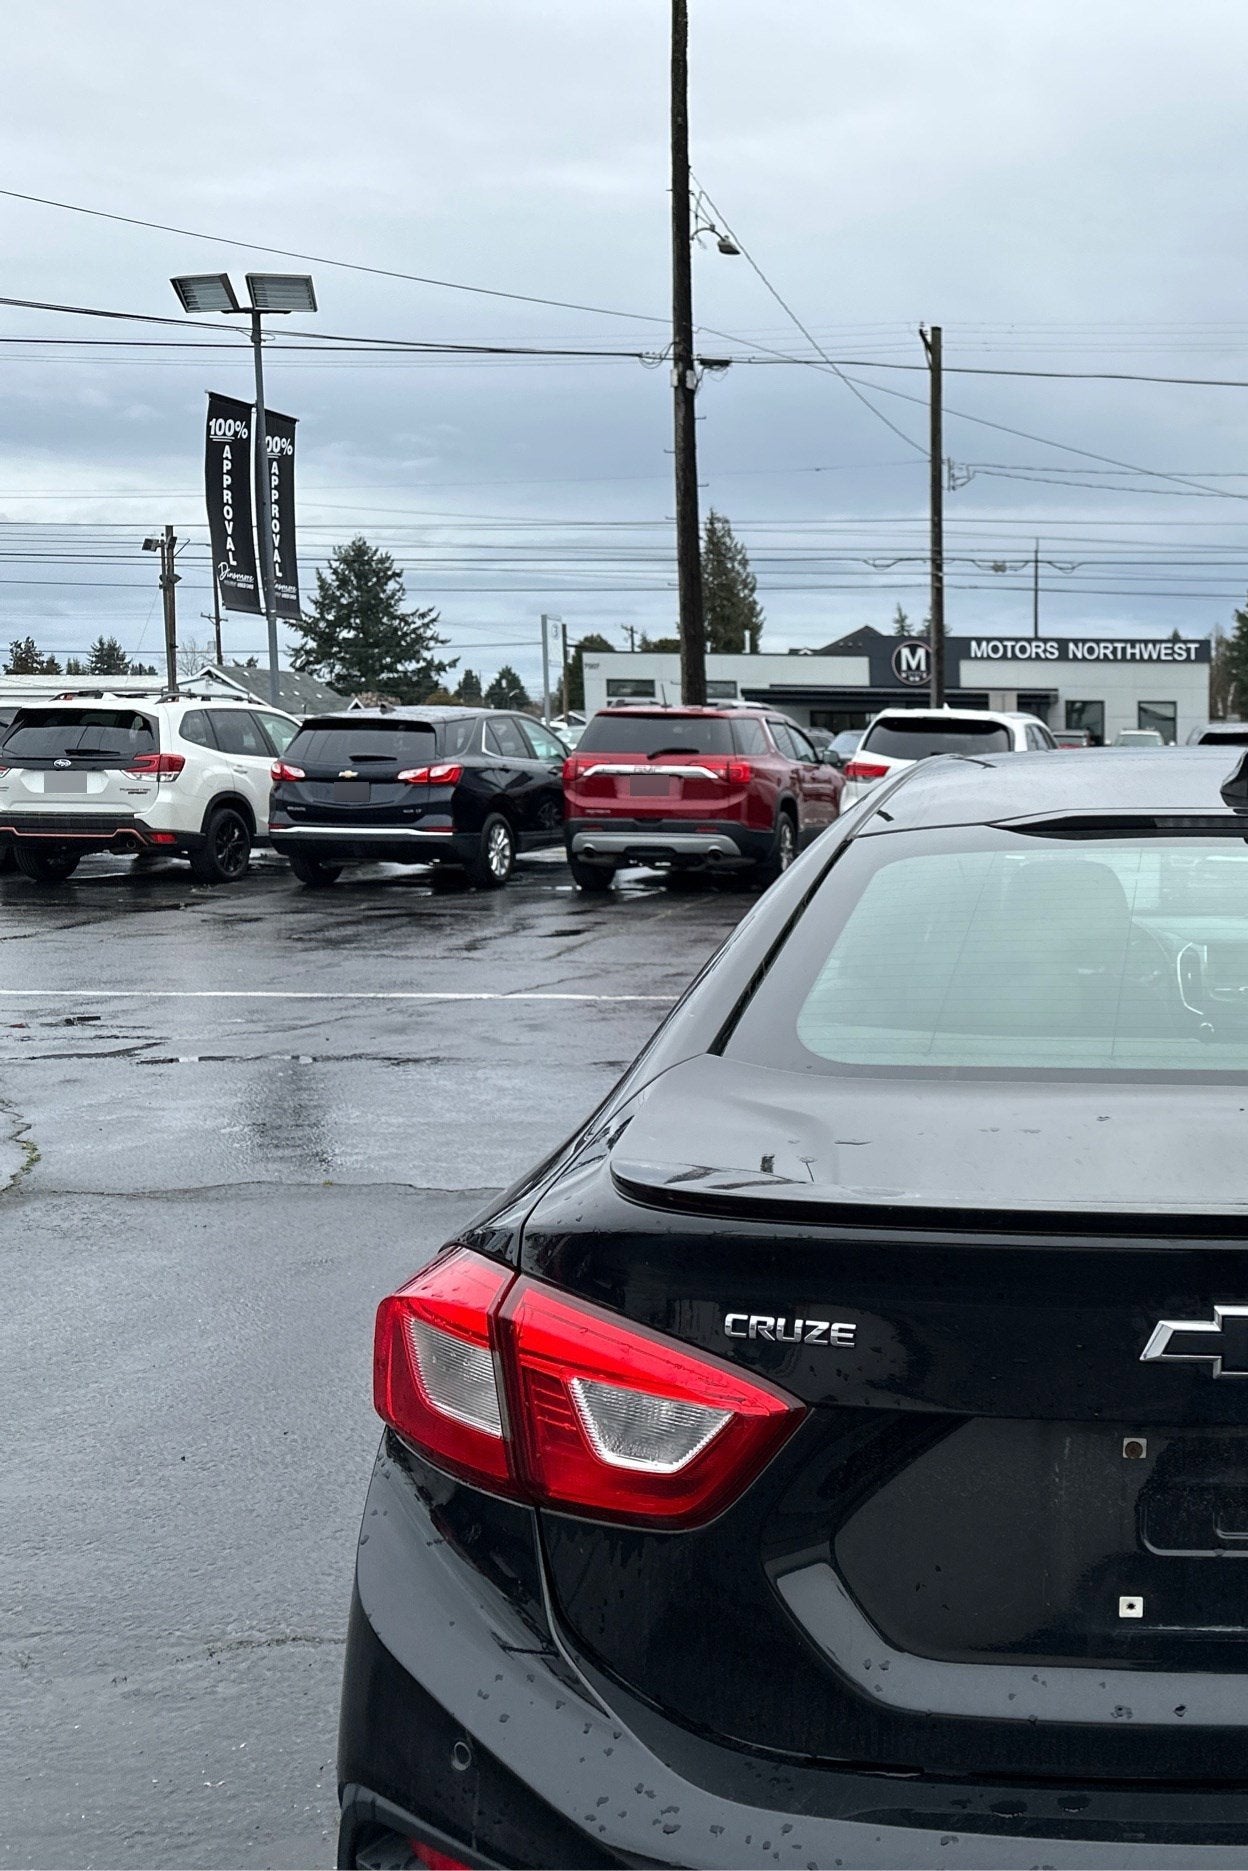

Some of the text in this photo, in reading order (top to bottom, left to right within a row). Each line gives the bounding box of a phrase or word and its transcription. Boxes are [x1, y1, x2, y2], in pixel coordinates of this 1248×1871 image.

[209, 418, 248, 439] 100%
[265, 436, 293, 456] 00%
[222, 444, 237, 566] APPROVAL
[271, 461, 283, 577] APPROVAL
[900, 647, 926, 671] M
[970, 640, 1200, 661] MOTORS NORTHWEST
[724, 1313, 857, 1348] CRUZE
